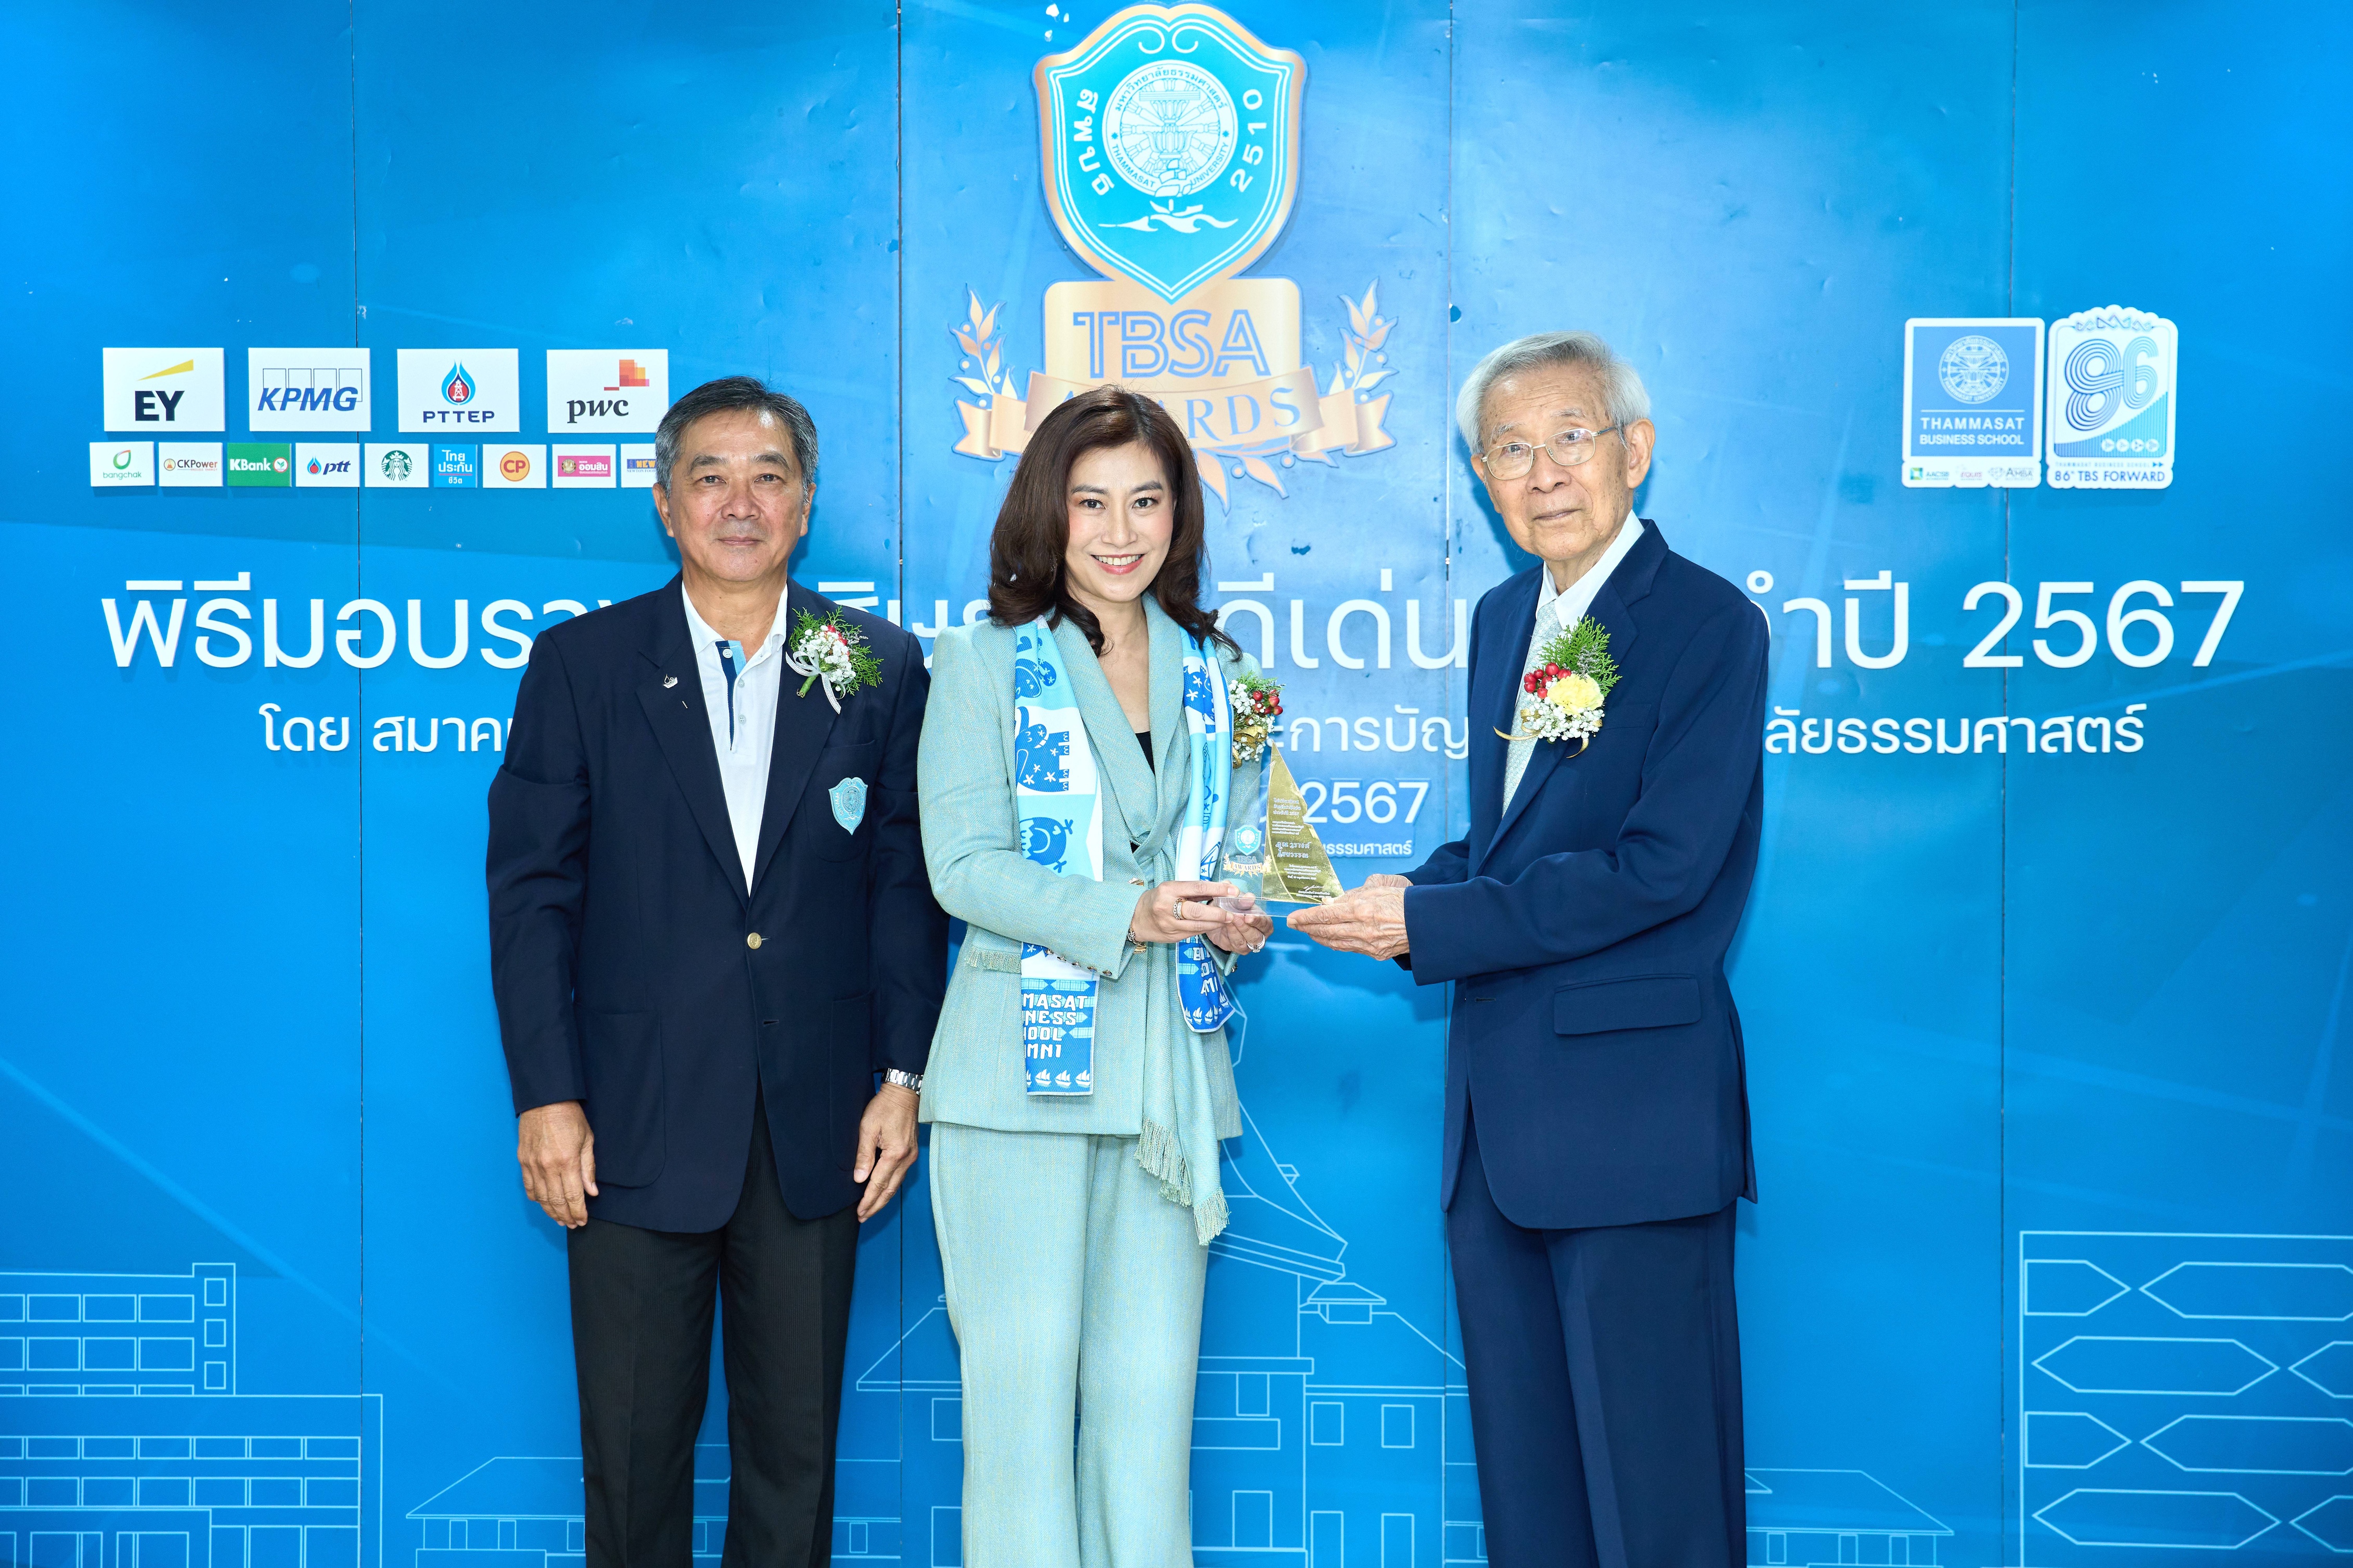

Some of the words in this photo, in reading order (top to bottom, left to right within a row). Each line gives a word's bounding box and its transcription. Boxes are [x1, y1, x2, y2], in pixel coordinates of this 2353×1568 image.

[1115, 67, 1228, 111] มหาวิทยาลัยธรรมศาสตร์
[1230, 89, 1266, 192] 2510
[1112, 144, 1156, 188] THAMMASAT
[1190, 142, 1229, 186] UNIVERSITY
[1072, 309, 1271, 379] TBSA
[2064, 336, 2159, 431] 86
[134, 390, 185, 421] EY
[257, 387, 358, 412] KPMG
[423, 410, 495, 423] PTTEP
[567, 399, 629, 424] pwc
[1920, 417, 2025, 430] THAMMASAT
[1919, 434, 1976, 445] BUSINESS
[1977, 434, 2025, 445] SCHOOL
[177, 459, 218, 468] CKPower
[442, 450, 465, 461] ไทย
[636, 459, 656, 468] NEW
[230, 458, 271, 471] KBank
[322, 461, 351, 475] ptt
[503, 460, 526, 473] CP
[103, 471, 142, 480] bangchak
[2079, 471, 2098, 481] TBS
[2104, 471, 2165, 481] FORWARD
[1963, 580, 2244, 668] 2567
[259, 702, 349, 752] โดย
[372, 715, 513, 753] สมาค
[1765, 703, 2147, 754] ลัยธรรมศาสตร์
[1302, 781, 1429, 824] 2567
[1323, 840, 1412, 855] ธรรมศาสตร์
[1236, 855, 1257, 864] TBSA
[1022, 1010, 1077, 1026] NESS
[1025, 1043, 1061, 1059] MNI
